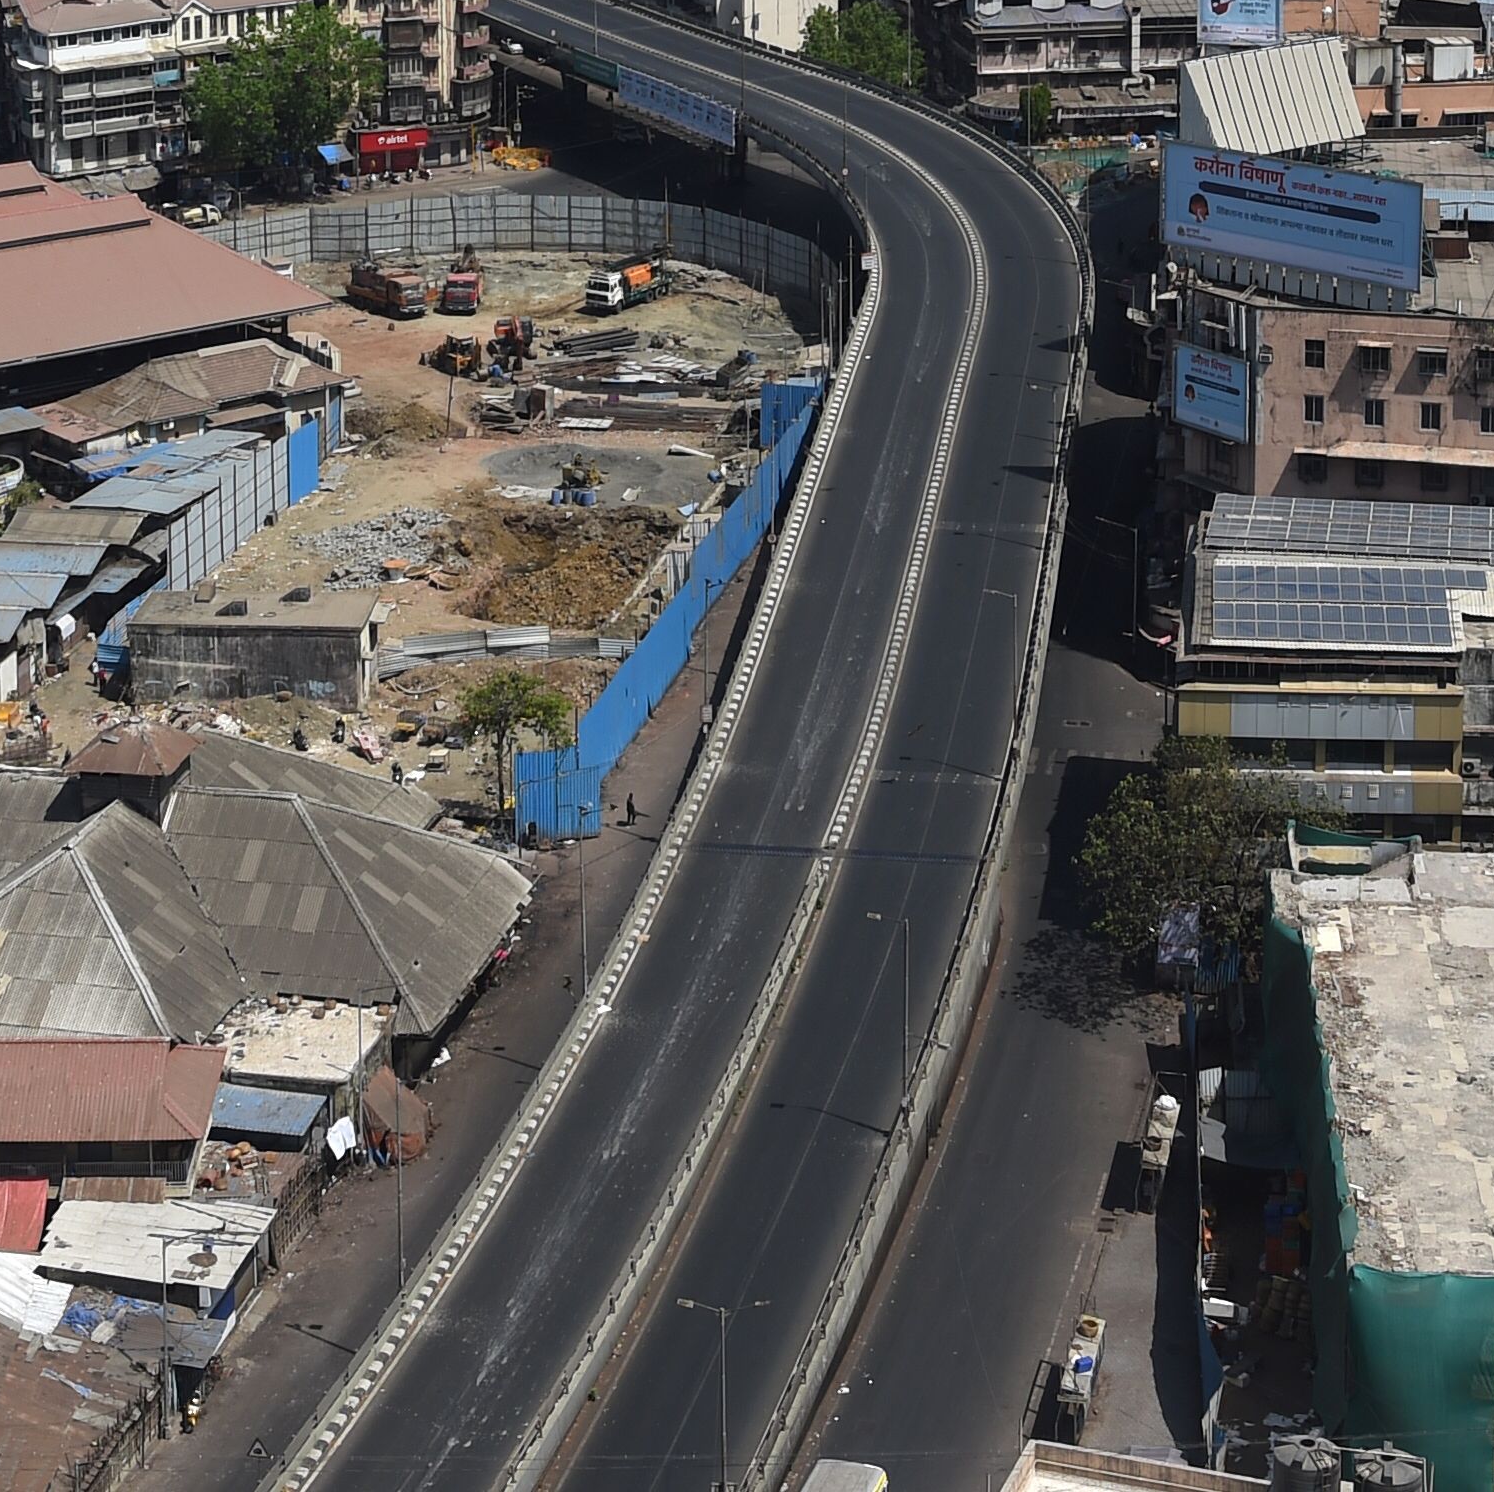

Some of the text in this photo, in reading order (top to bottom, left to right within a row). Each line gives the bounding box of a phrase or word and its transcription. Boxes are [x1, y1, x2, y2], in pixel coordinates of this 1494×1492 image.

[386, 134, 408, 145] airtel
[1193, 156, 1287, 194] करोना विषाणू
